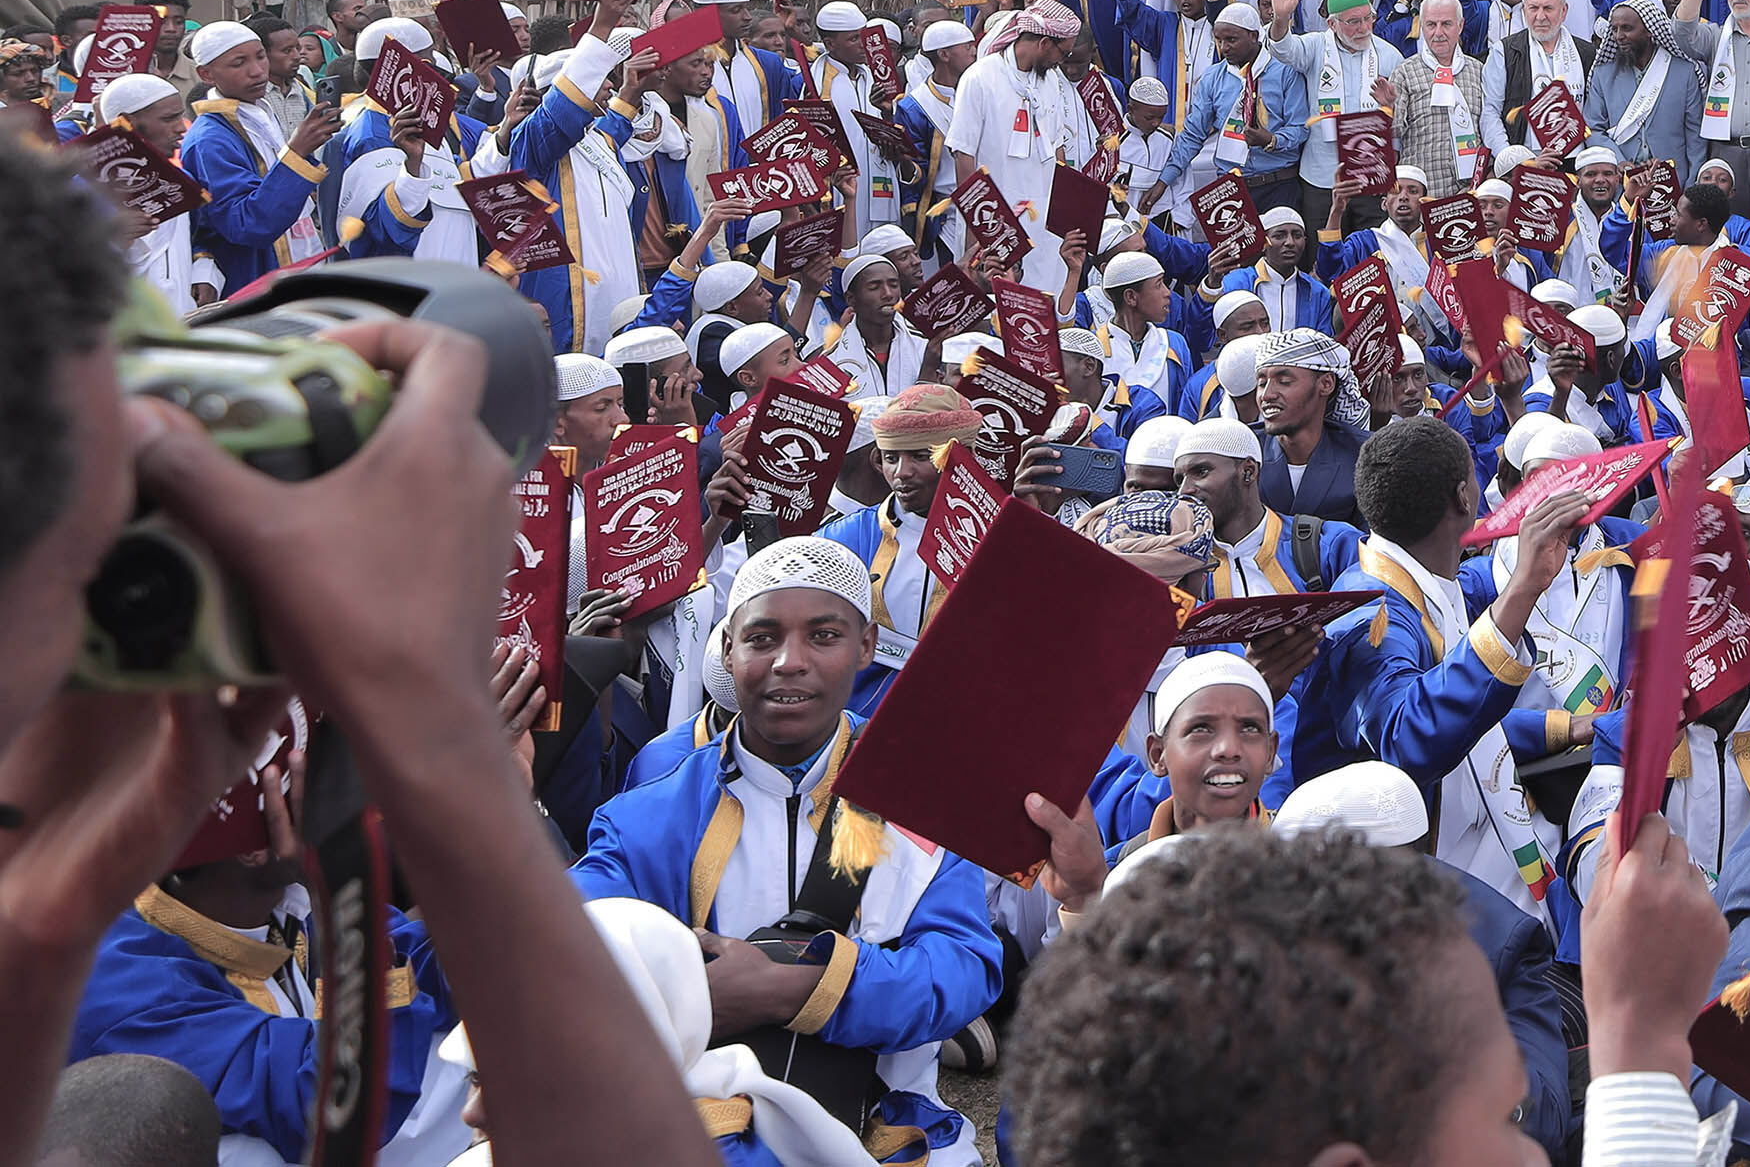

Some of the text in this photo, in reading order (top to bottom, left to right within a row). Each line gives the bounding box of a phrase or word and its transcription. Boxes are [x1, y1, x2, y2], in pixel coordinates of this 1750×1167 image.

[529, 470, 543, 483] FOR
[527, 483, 550, 496] QURAN
[748, 495, 773, 511] 2026
[602, 550, 663, 585] Congratulations
[1683, 625, 1729, 665] gratulations
[1689, 661, 1717, 689] 2026
